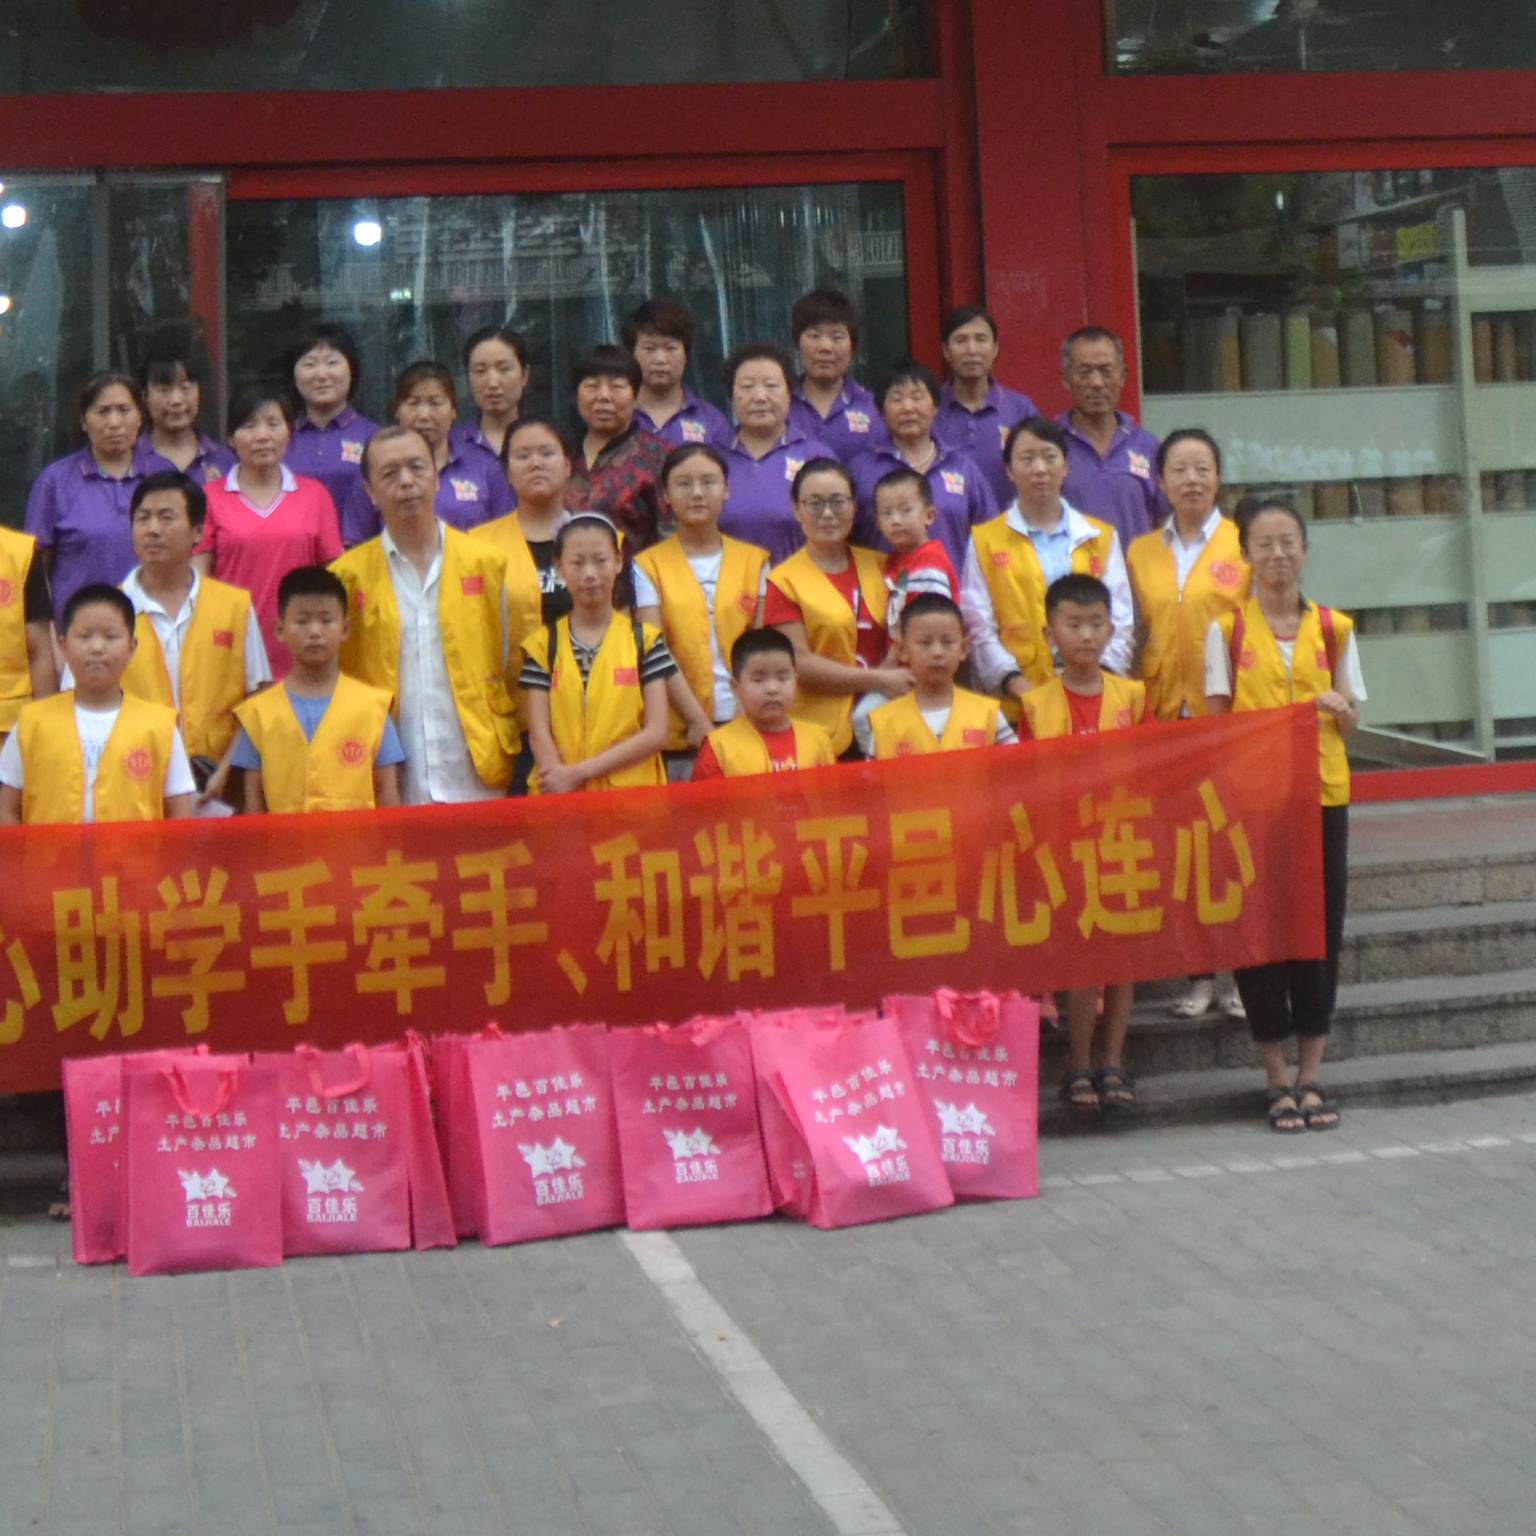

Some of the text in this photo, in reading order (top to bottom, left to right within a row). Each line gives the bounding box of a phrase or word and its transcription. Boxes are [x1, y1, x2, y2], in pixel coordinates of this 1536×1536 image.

[496, 1072, 584, 1101] 平邑百佳乐
[649, 1072, 729, 1092] 平邑百佳乐
[95, 1098, 121, 1118] 平
[285, 1097, 379, 1115] 平邑百佳乐
[492, 1096, 597, 1129] 土产杂品超市
[642, 1093, 738, 1115] 土产杂品超市
[166, 1112, 247, 1129] 平邑百佳乐
[279, 1122, 389, 1141] 土产杂品超市
[157, 1135, 257, 1153] 土产杂品超市
[942, 1138, 990, 1157] 百佳乐
[674, 1159, 719, 1177] 百佳乐
[534, 1173, 583, 1197] 百佳乐
[186, 1203, 231, 1220] 百佳乐
[306, 1197, 358, 1215] 百佳乐
